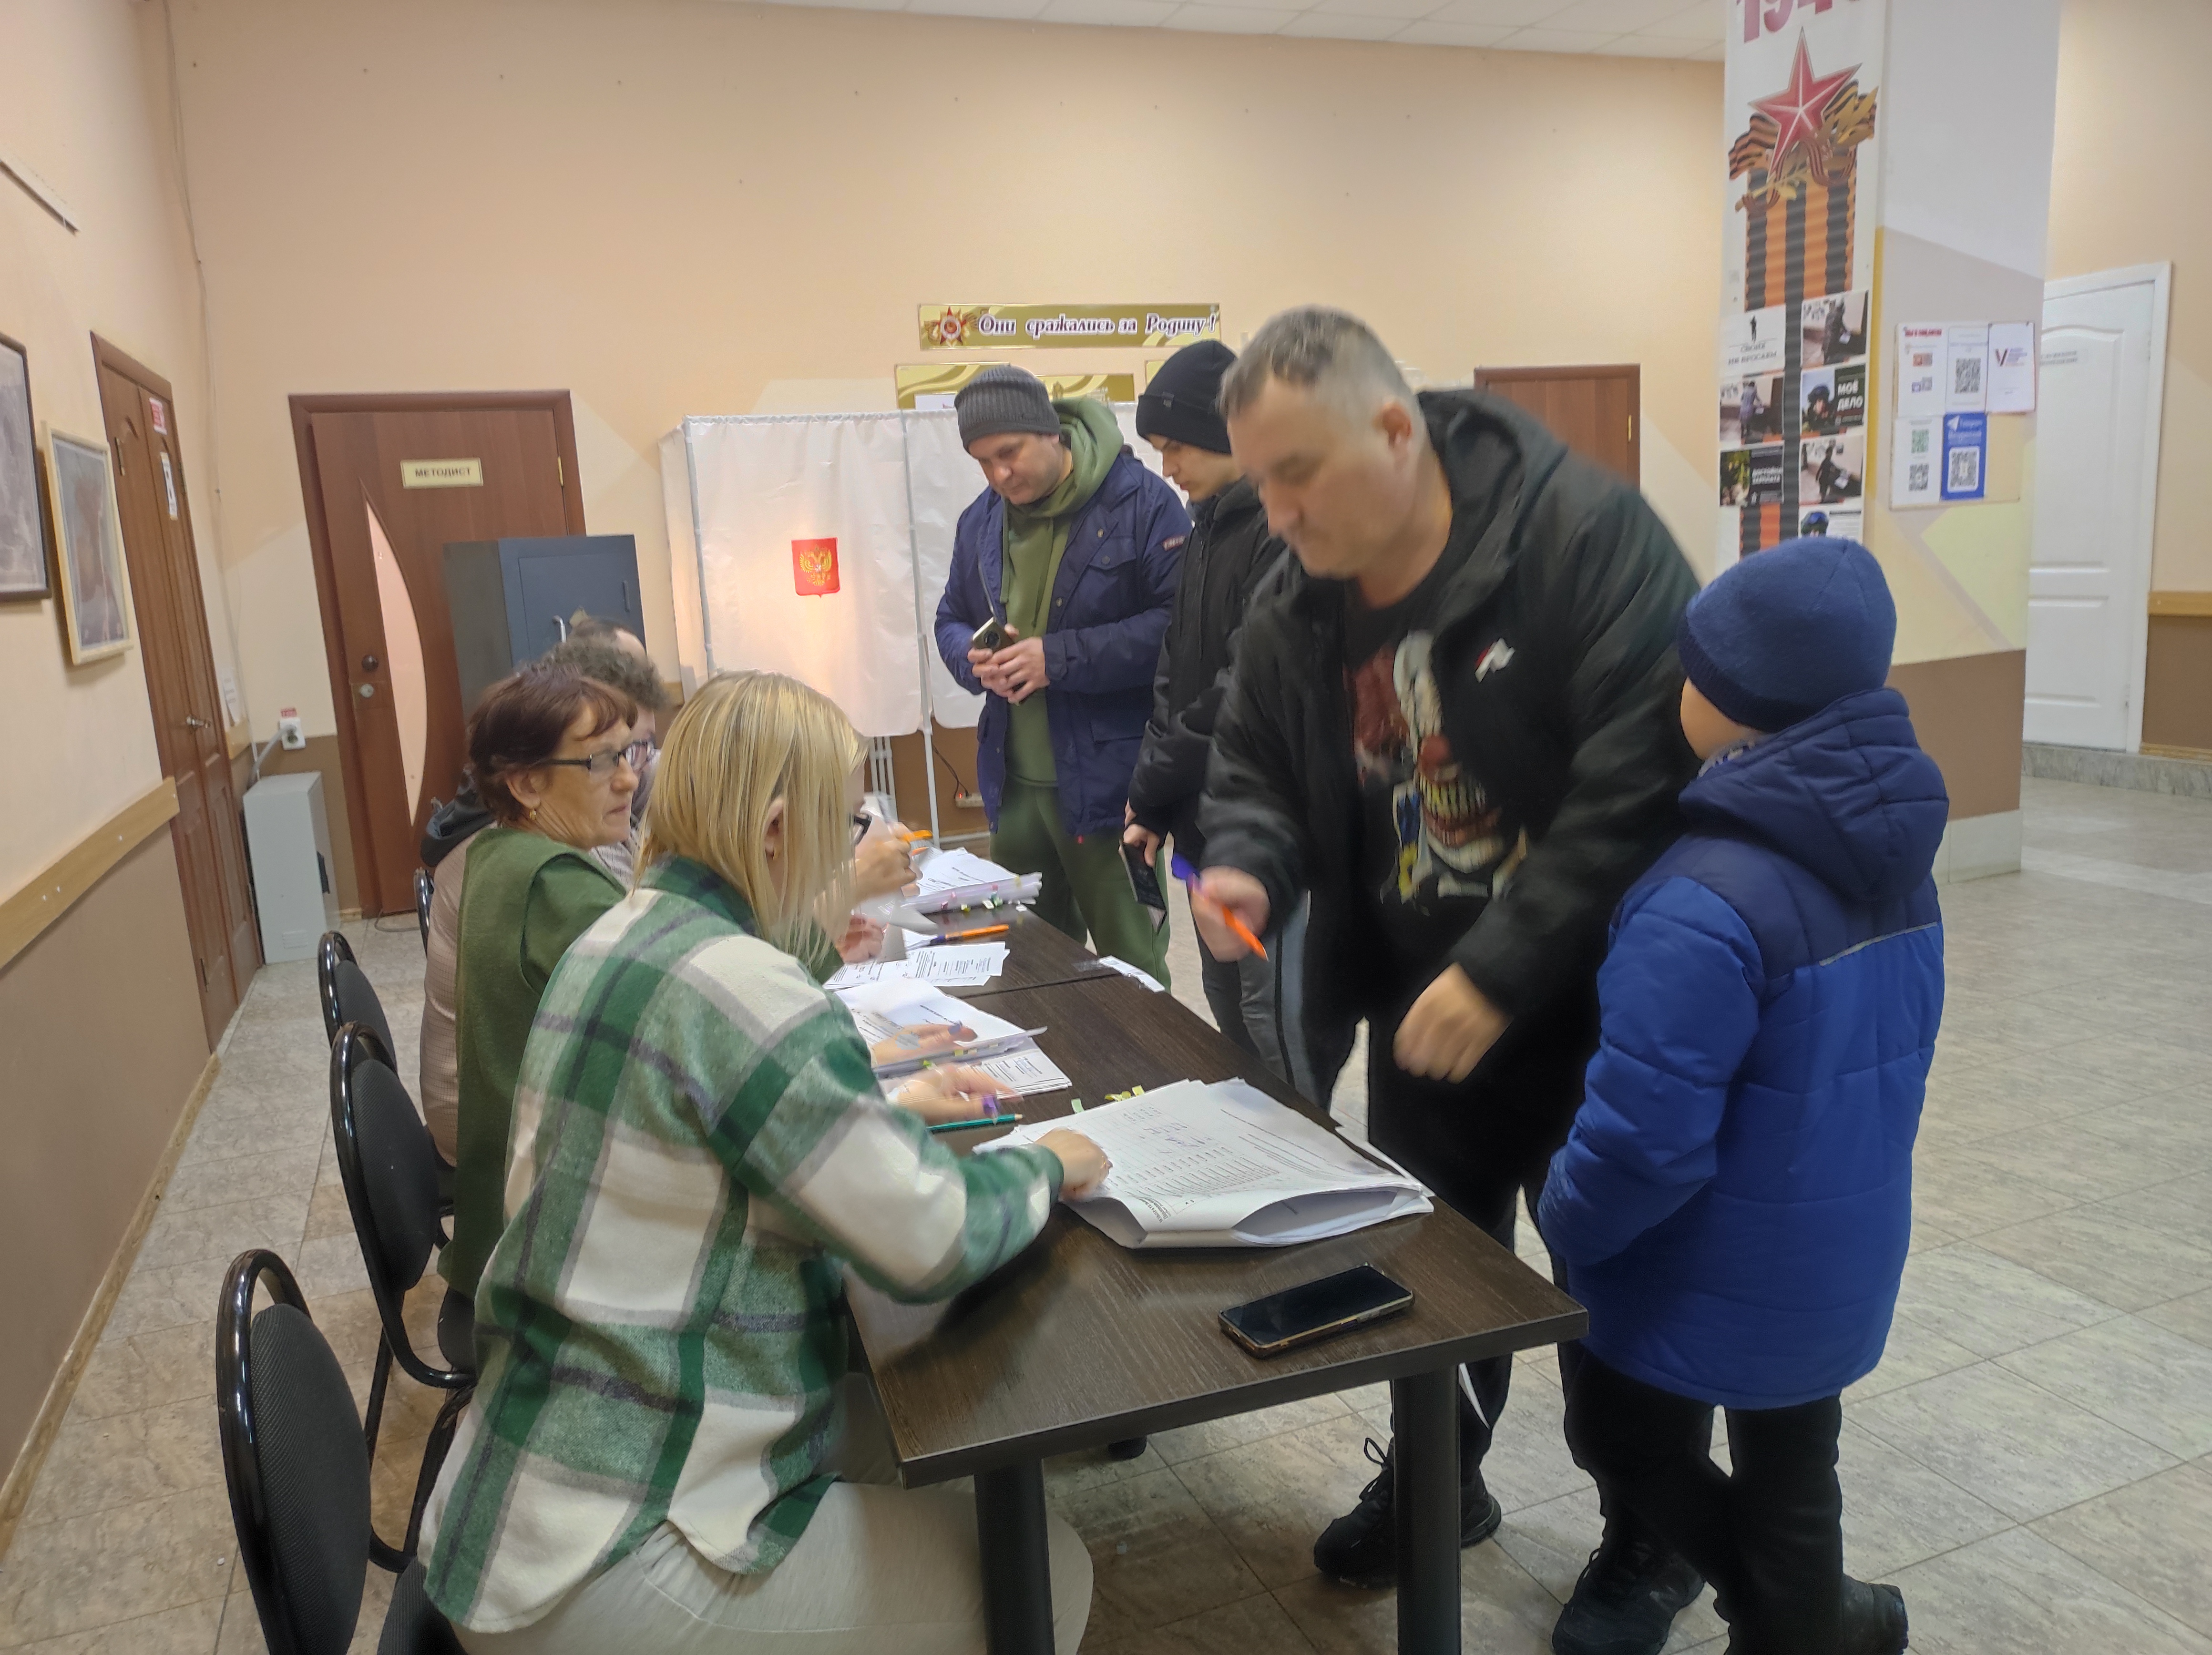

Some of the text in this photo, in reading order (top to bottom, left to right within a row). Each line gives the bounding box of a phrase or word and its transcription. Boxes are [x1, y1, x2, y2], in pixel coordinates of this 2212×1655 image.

[979, 314, 1016, 335] Они
[1026, 313, 1115, 339] сражались
[1118, 317, 1137, 335] за
[415, 468, 470, 477] МЕТОДИСТ
